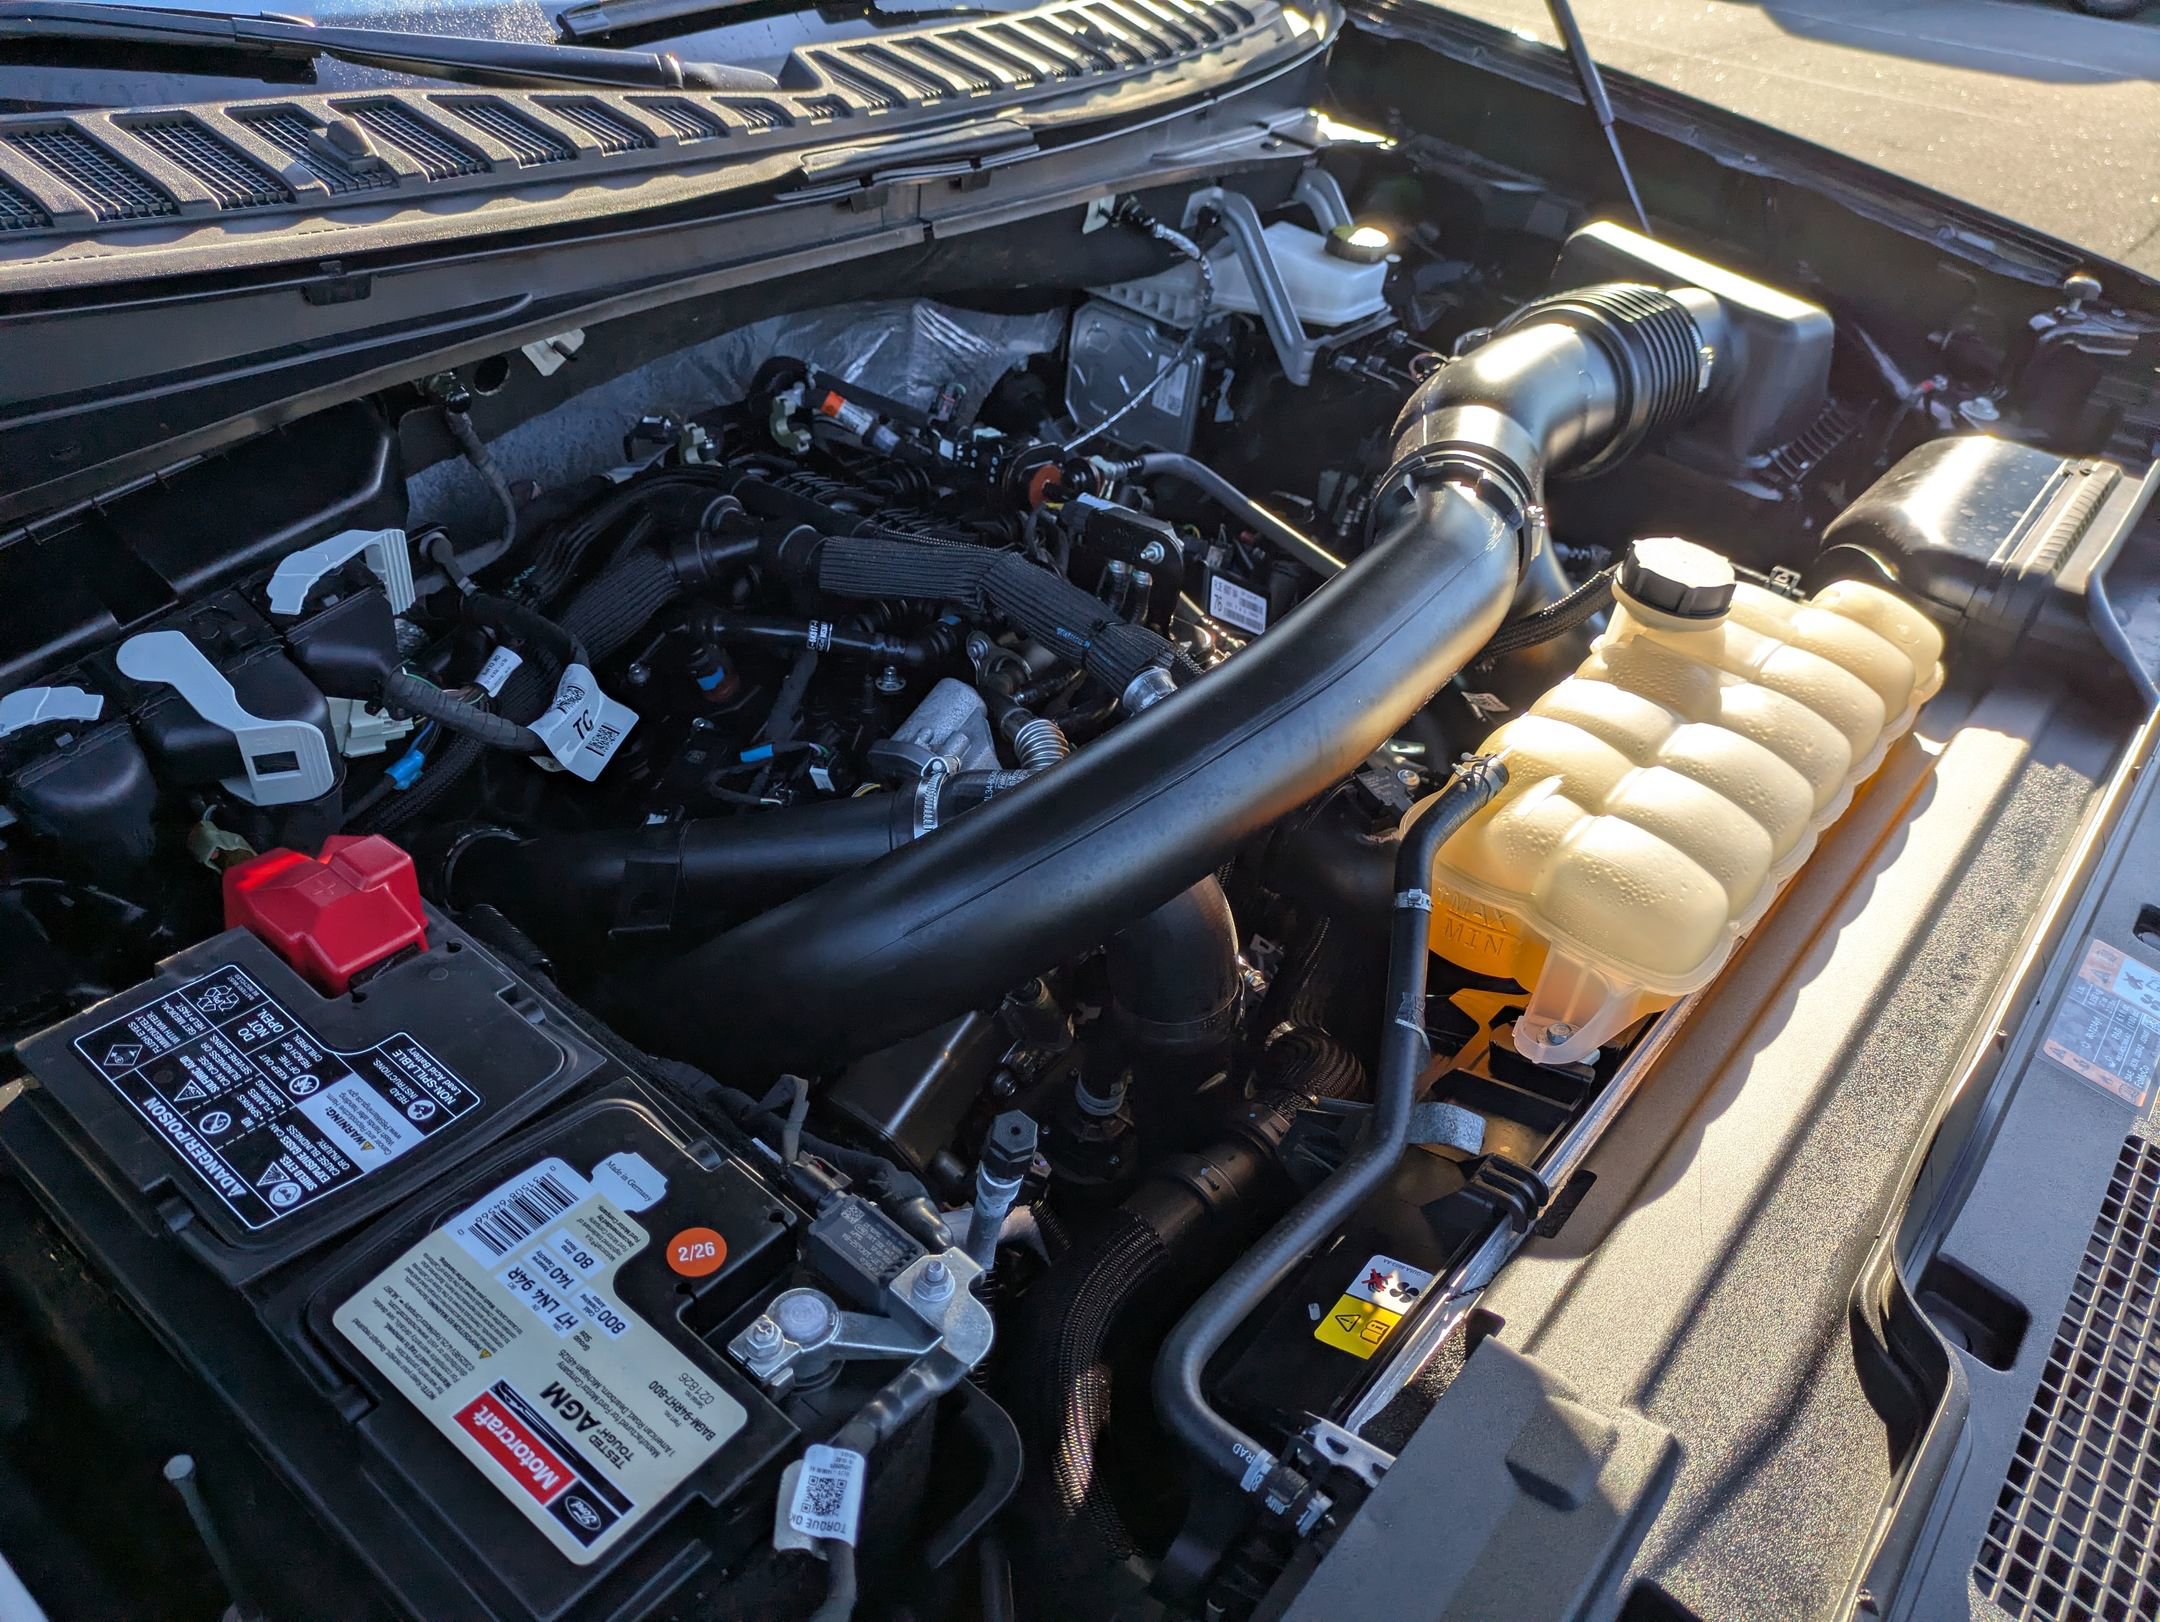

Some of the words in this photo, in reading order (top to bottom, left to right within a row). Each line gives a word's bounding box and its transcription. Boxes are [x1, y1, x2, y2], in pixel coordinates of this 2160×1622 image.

[573, 709, 594, 740] TC
[1452, 892, 1508, 931] MAX
[1444, 918, 1505, 956] MIN
[159, 1001, 186, 1024] MEDICAL
[174, 1002, 194, 1017] FAST.
[127, 1021, 146, 1036] EYES
[134, 1014, 172, 1048] IMMEDIATELY
[144, 1010, 169, 1031] WATER.
[180, 1022, 197, 1035] GET
[188, 1015, 207, 1030] HELP
[246, 1019, 270, 1037] NOT
[254, 1008, 285, 1033] OPEN.
[140, 1034, 162, 1053] FLUSH
[163, 1028, 181, 1043] WITH
[207, 1033, 232, 1054] BURNS.
[236, 1027, 255, 1041] DO
[200, 1041, 213, 1052] OR
[281, 1040, 294, 1050] OF
[290, 1033, 324, 1061] CHILDREN.
[179, 1054, 198, 1070] ACID
[197, 1055, 221, 1076] CAUSE
[208, 1049, 242, 1080] BLINDNESS
[227, 1052, 253, 1074] SEVERE
[258, 1052, 276, 1067] OUT
[278, 1054, 293, 1066] THE
[289, 1048, 313, 1068] REACH
[405, 1046, 433, 1068] Battery
[271, 1065, 290, 1080] KEEP
[287, 1063, 301, 1074] OF
[371, 1058, 419, 1099] INSTRUCTIONS.
[391, 1048, 456, 1104] NON-SPILLABLE
[427, 1066, 446, 1081] Acid
[191, 1067, 220, 1092] SULFURIC
[216, 1073, 231, 1086] CAN
[441, 1078, 462, 1094] Lead
[247, 1088, 273, 1111] FLAMES
[254, 1078, 285, 1105] SMOKING
[388, 1086, 410, 1104] READ
[235, 1094, 262, 1117] SPARKS
[240, 1116, 254, 1127] NO
[267, 1123, 285, 1137] CAN
[323, 1106, 366, 1144] WARNING:
[142, 1096, 237, 1188] DANGER/POISON
[279, 1135, 302, 1154] GASES
[285, 1124, 322, 1157] BLINDNESS
[314, 1137, 341, 1160] INJURY.
[277, 1153, 299, 1171] EYES.
[295, 1151, 331, 1182] EXPLOSIVE
[316, 1154, 341, 1176] CAUSE
[336, 1158, 351, 1170] OR
[293, 1168, 318, 1190] SHIELD
[508, 1174, 542, 1201] 31508
[606, 1160, 621, 1176] Made
[620, 1172, 630, 1182] in
[627, 1177, 652, 1202] Germany
[474, 1198, 508, 1224] 64566
[615, 1221, 631, 1234] Motor
[627, 1231, 641, 1242] Ford
[559, 1244, 573, 1255] Amp
[563, 1238, 578, 1251] Hours
[678, 1242, 715, 1262] 2/26
[530, 1255, 550, 1272] Reserve
[534, 1249, 556, 1268] Capacity
[571, 1250, 595, 1270] 80
[506, 1266, 537, 1292] 94R
[547, 1266, 575, 1289] 140
[529, 1287, 560, 1313] LN4
[579, 1292, 602, 1312] Cranking
[591, 1294, 607, 1308] Amps
[554, 1309, 579, 1330] H7
[582, 1305, 595, 1317] Cold
[595, 1308, 626, 1334] 800
[571, 1334, 591, 1351] Group
[578, 1329, 593, 1342] Size
[554, 1359, 585, 1386] Company
[573, 1362, 603, 1389] Michigan
[578, 1383, 600, 1402] Motor
[677, 1371, 715, 1405] 021826
[537, 1380, 602, 1438] AGM
[595, 1398, 613, 1414] Ford
[597, 1385, 629, 1414] Dearborn,
[646, 1379, 717, 1441] BAGM-94RH7-800
[689, 1395, 704, 1409] Serial
[609, 1411, 621, 1422] for
[624, 1409, 646, 1429] Road,
[668, 1415, 681, 1427] Part
[468, 1404, 561, 1490] Motorcraft
[616, 1417, 661, 1458] Manufactured
[640, 1424, 673, 1454] American
[586, 1433, 627, 1469] TESTED
[1232, 1443, 1255, 1464] RAD
[566, 1498, 599, 1528] Ford
[806, 1519, 847, 1534] TORQUE
